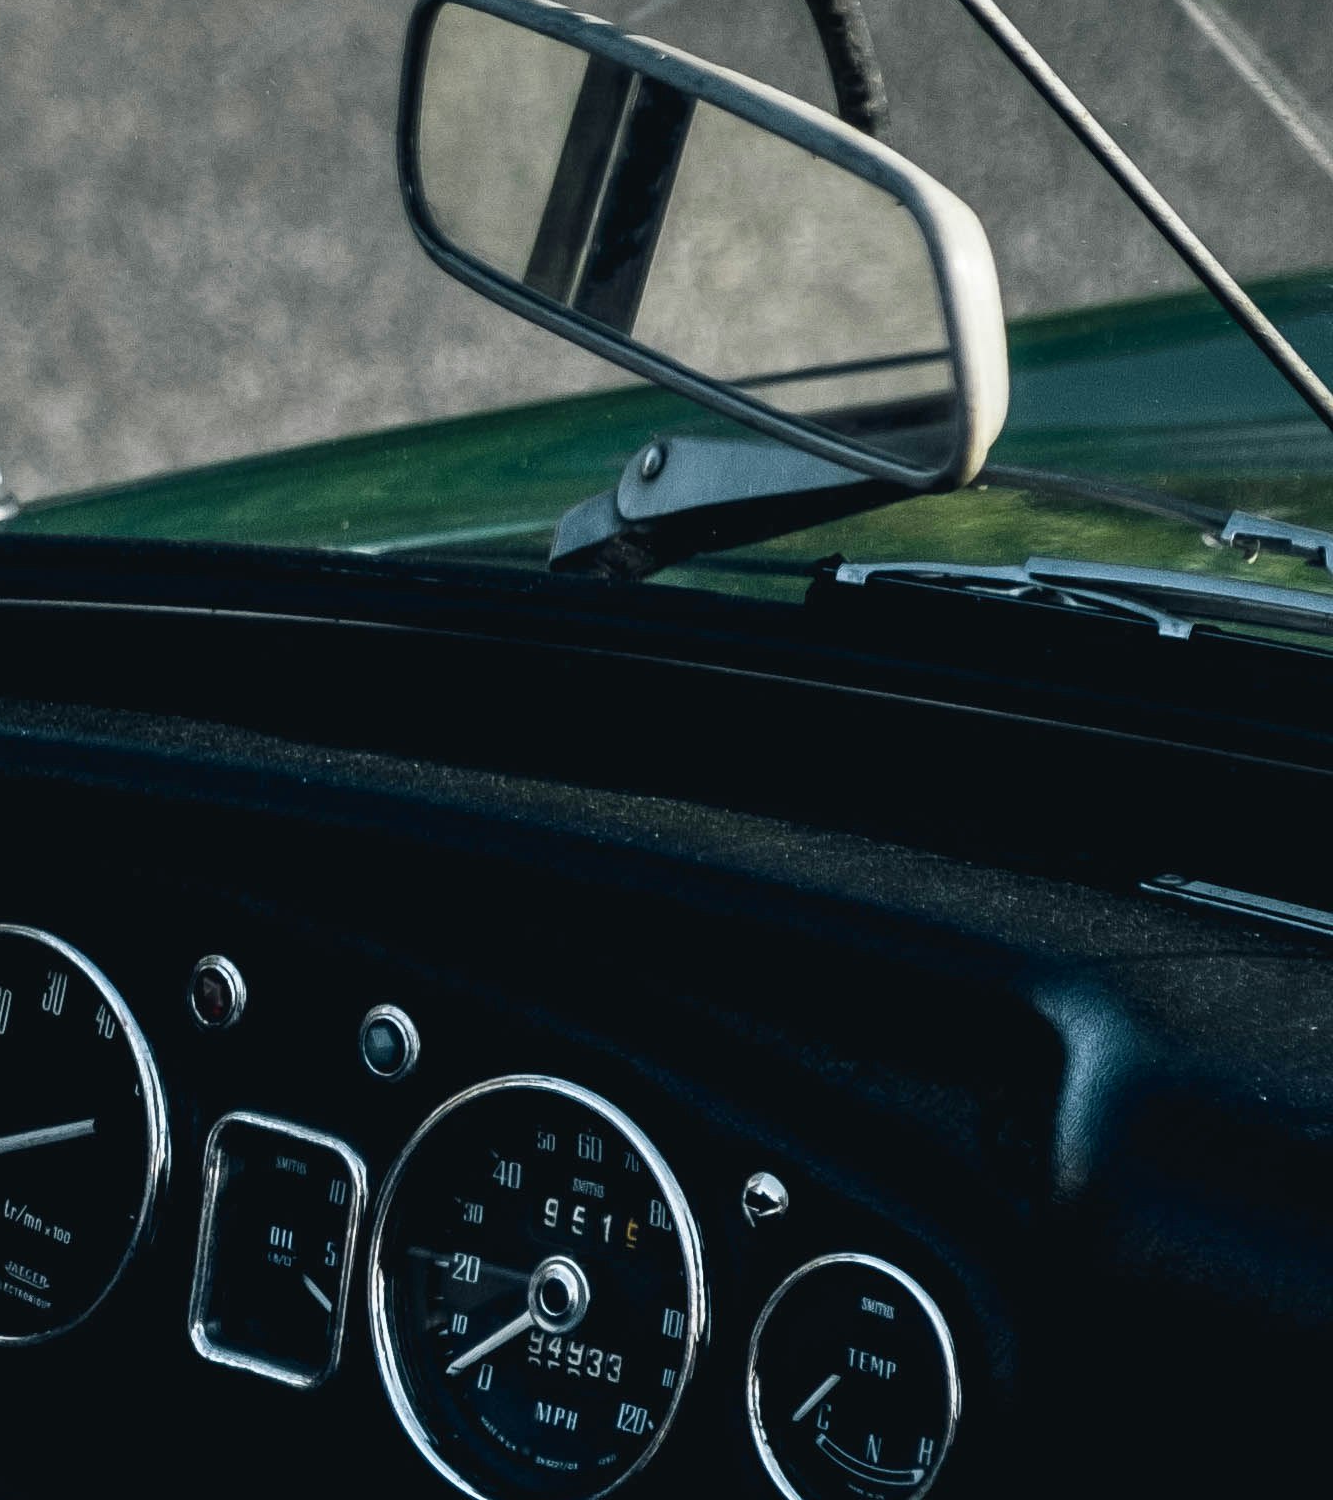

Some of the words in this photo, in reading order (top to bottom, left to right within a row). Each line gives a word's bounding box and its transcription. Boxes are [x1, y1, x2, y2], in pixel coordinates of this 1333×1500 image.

[42, 969, 68, 1016] 30
[536, 1130, 557, 1153] 50
[577, 1131, 604, 1164] 60
[492, 1159, 522, 1189] 40
[462, 1202, 484, 1225] 30
[269, 1224, 294, 1251] OIL
[4, 1259, 51, 1290] JAEGER
[452, 1251, 481, 1284] 20
[860, 1295, 896, 1321] SMITHS
[451, 1312, 469, 1336] 10
[476, 1362, 494, 1392] 0
[847, 1346, 897, 1381] TEMP
[534, 1400, 579, 1433] MPH
[616, 1402, 649, 1436] 120
[817, 1403, 832, 1431] C
[865, 1433, 883, 1465] N
[917, 1435, 934, 1467] H
